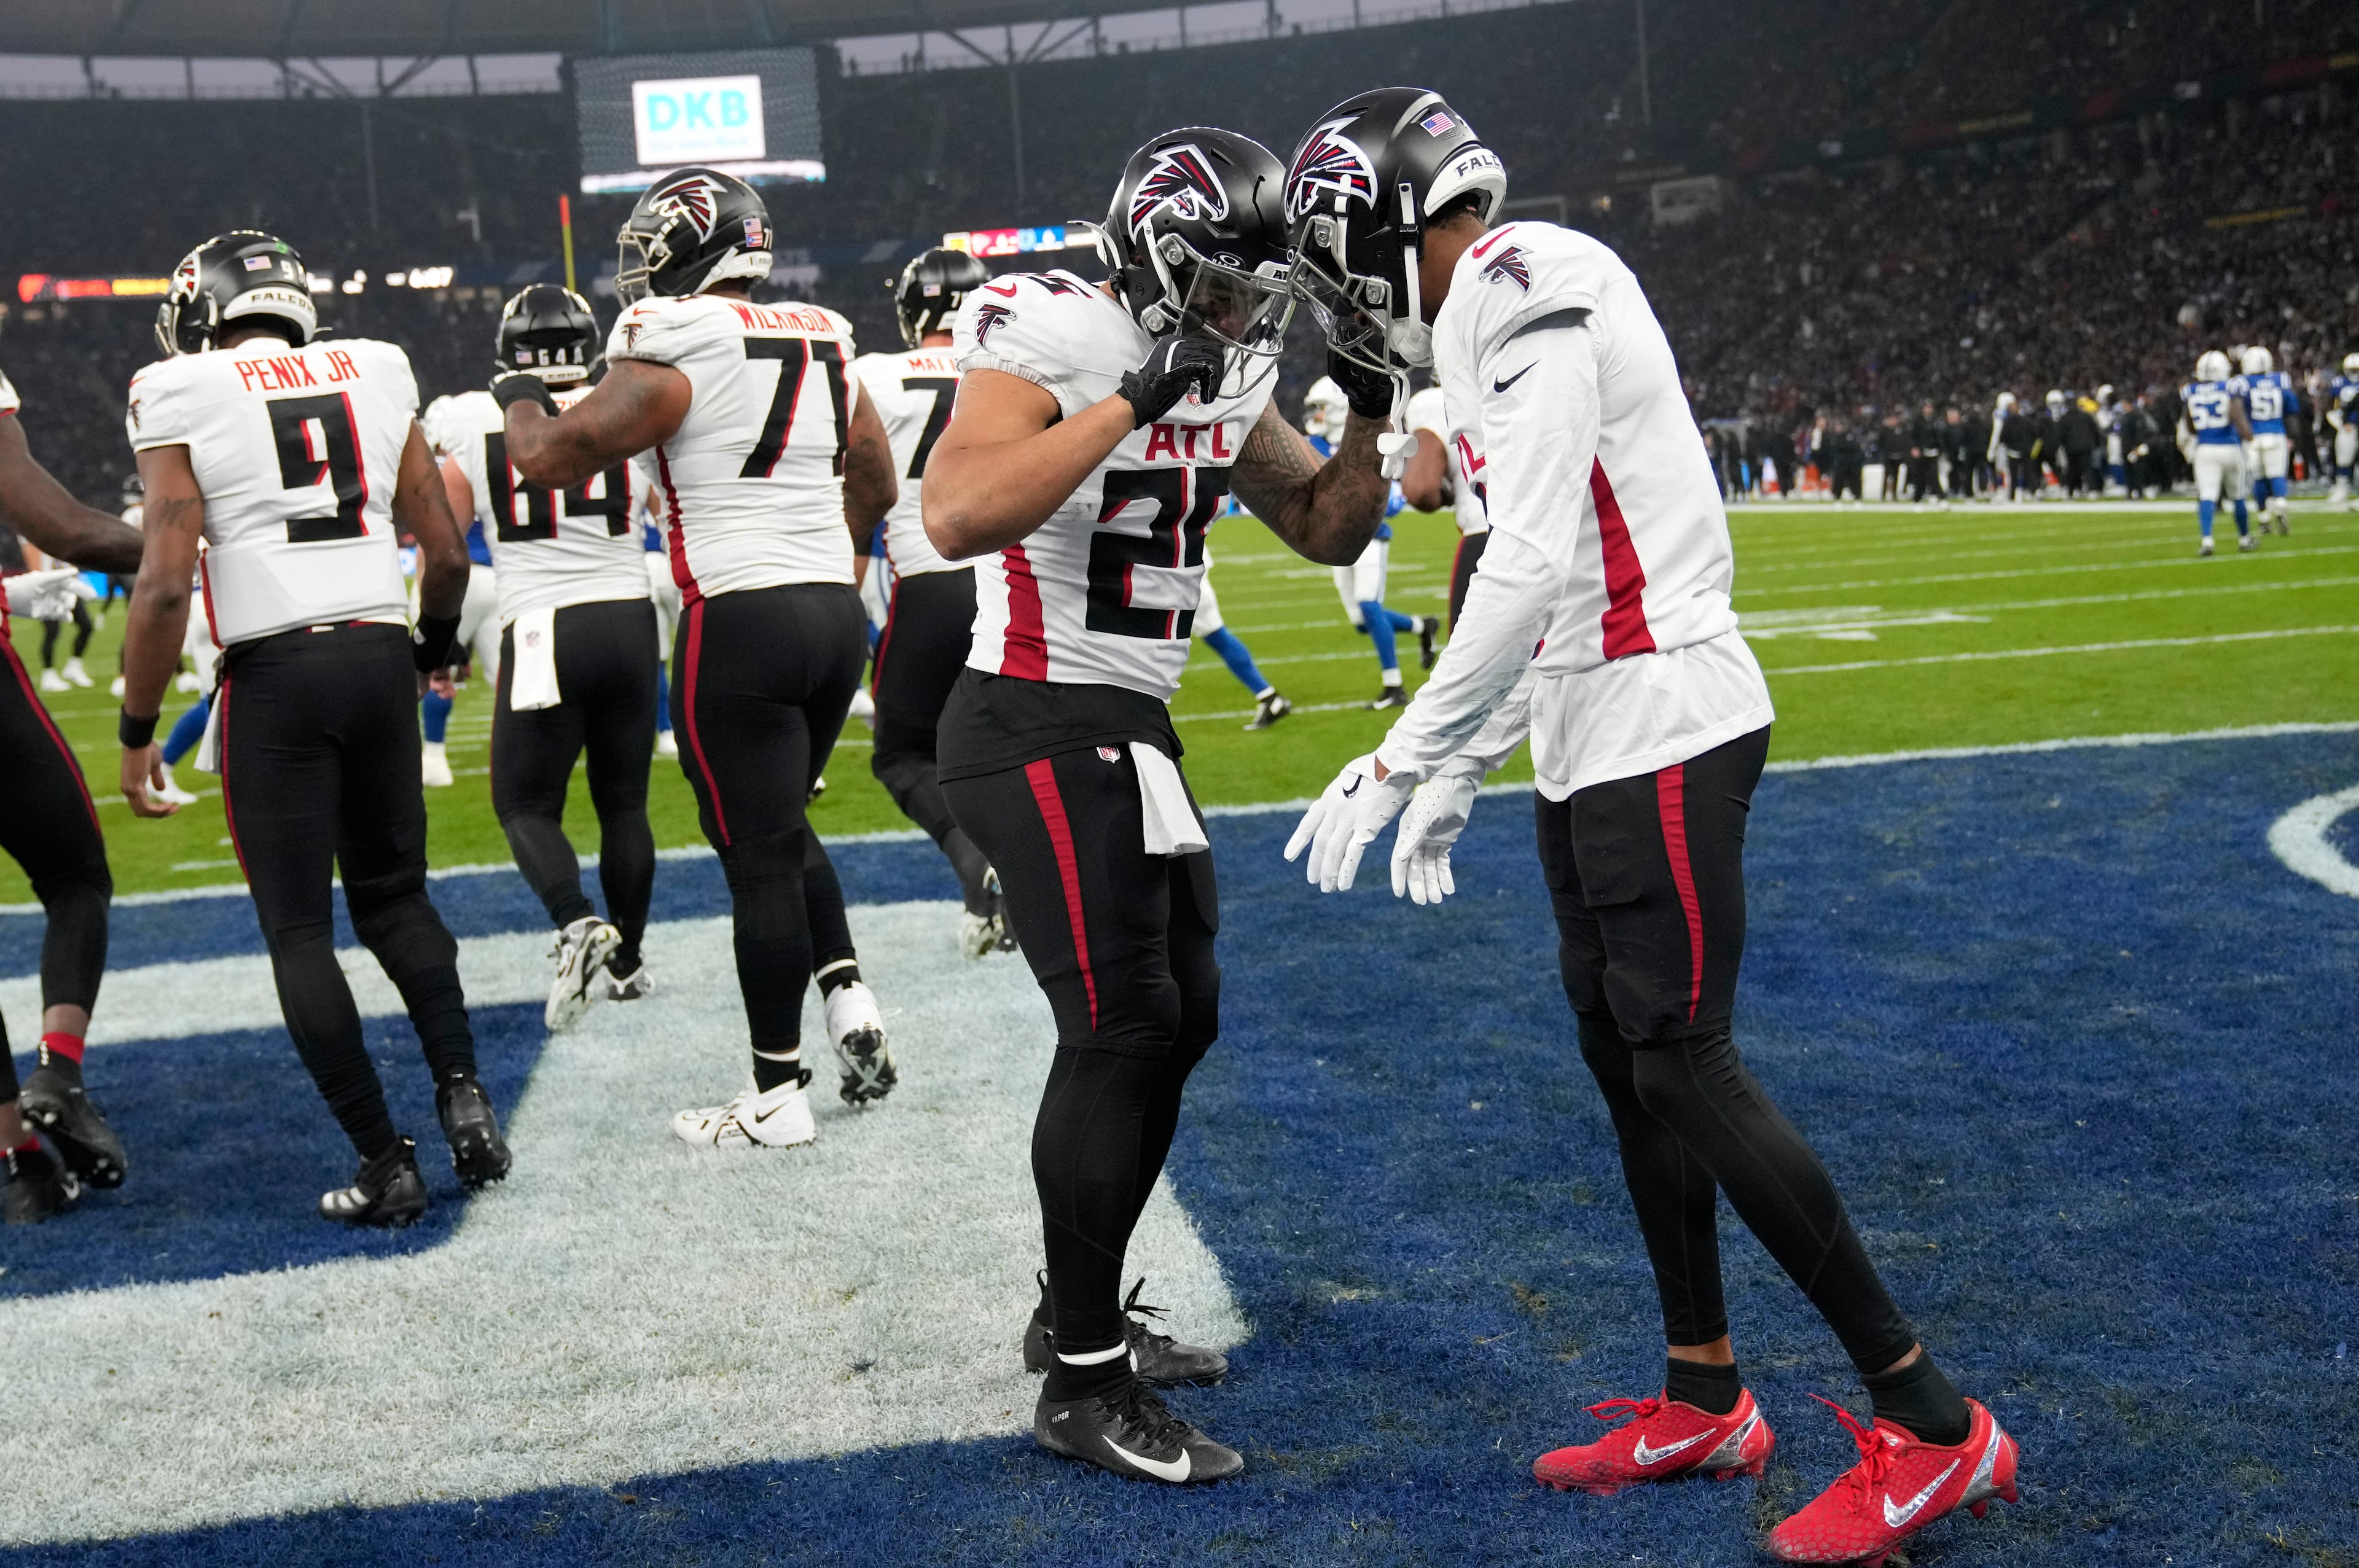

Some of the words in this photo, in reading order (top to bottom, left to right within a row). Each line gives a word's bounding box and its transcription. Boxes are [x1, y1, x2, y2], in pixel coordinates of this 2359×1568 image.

[647, 90, 749, 131] DKB
[280, 260, 294, 281] 9
[728, 303, 835, 333] WILKINSON
[234, 354, 318, 392] PENIX
[325, 351, 361, 382] JR
[738, 337, 850, 478] 71
[2188, 391, 2231, 430] 53
[2250, 387, 2283, 421] 51
[1145, 422, 1230, 461] ATL
[265, 391, 369, 544] 9
[1051, 1410, 1070, 1424] VAPOR
